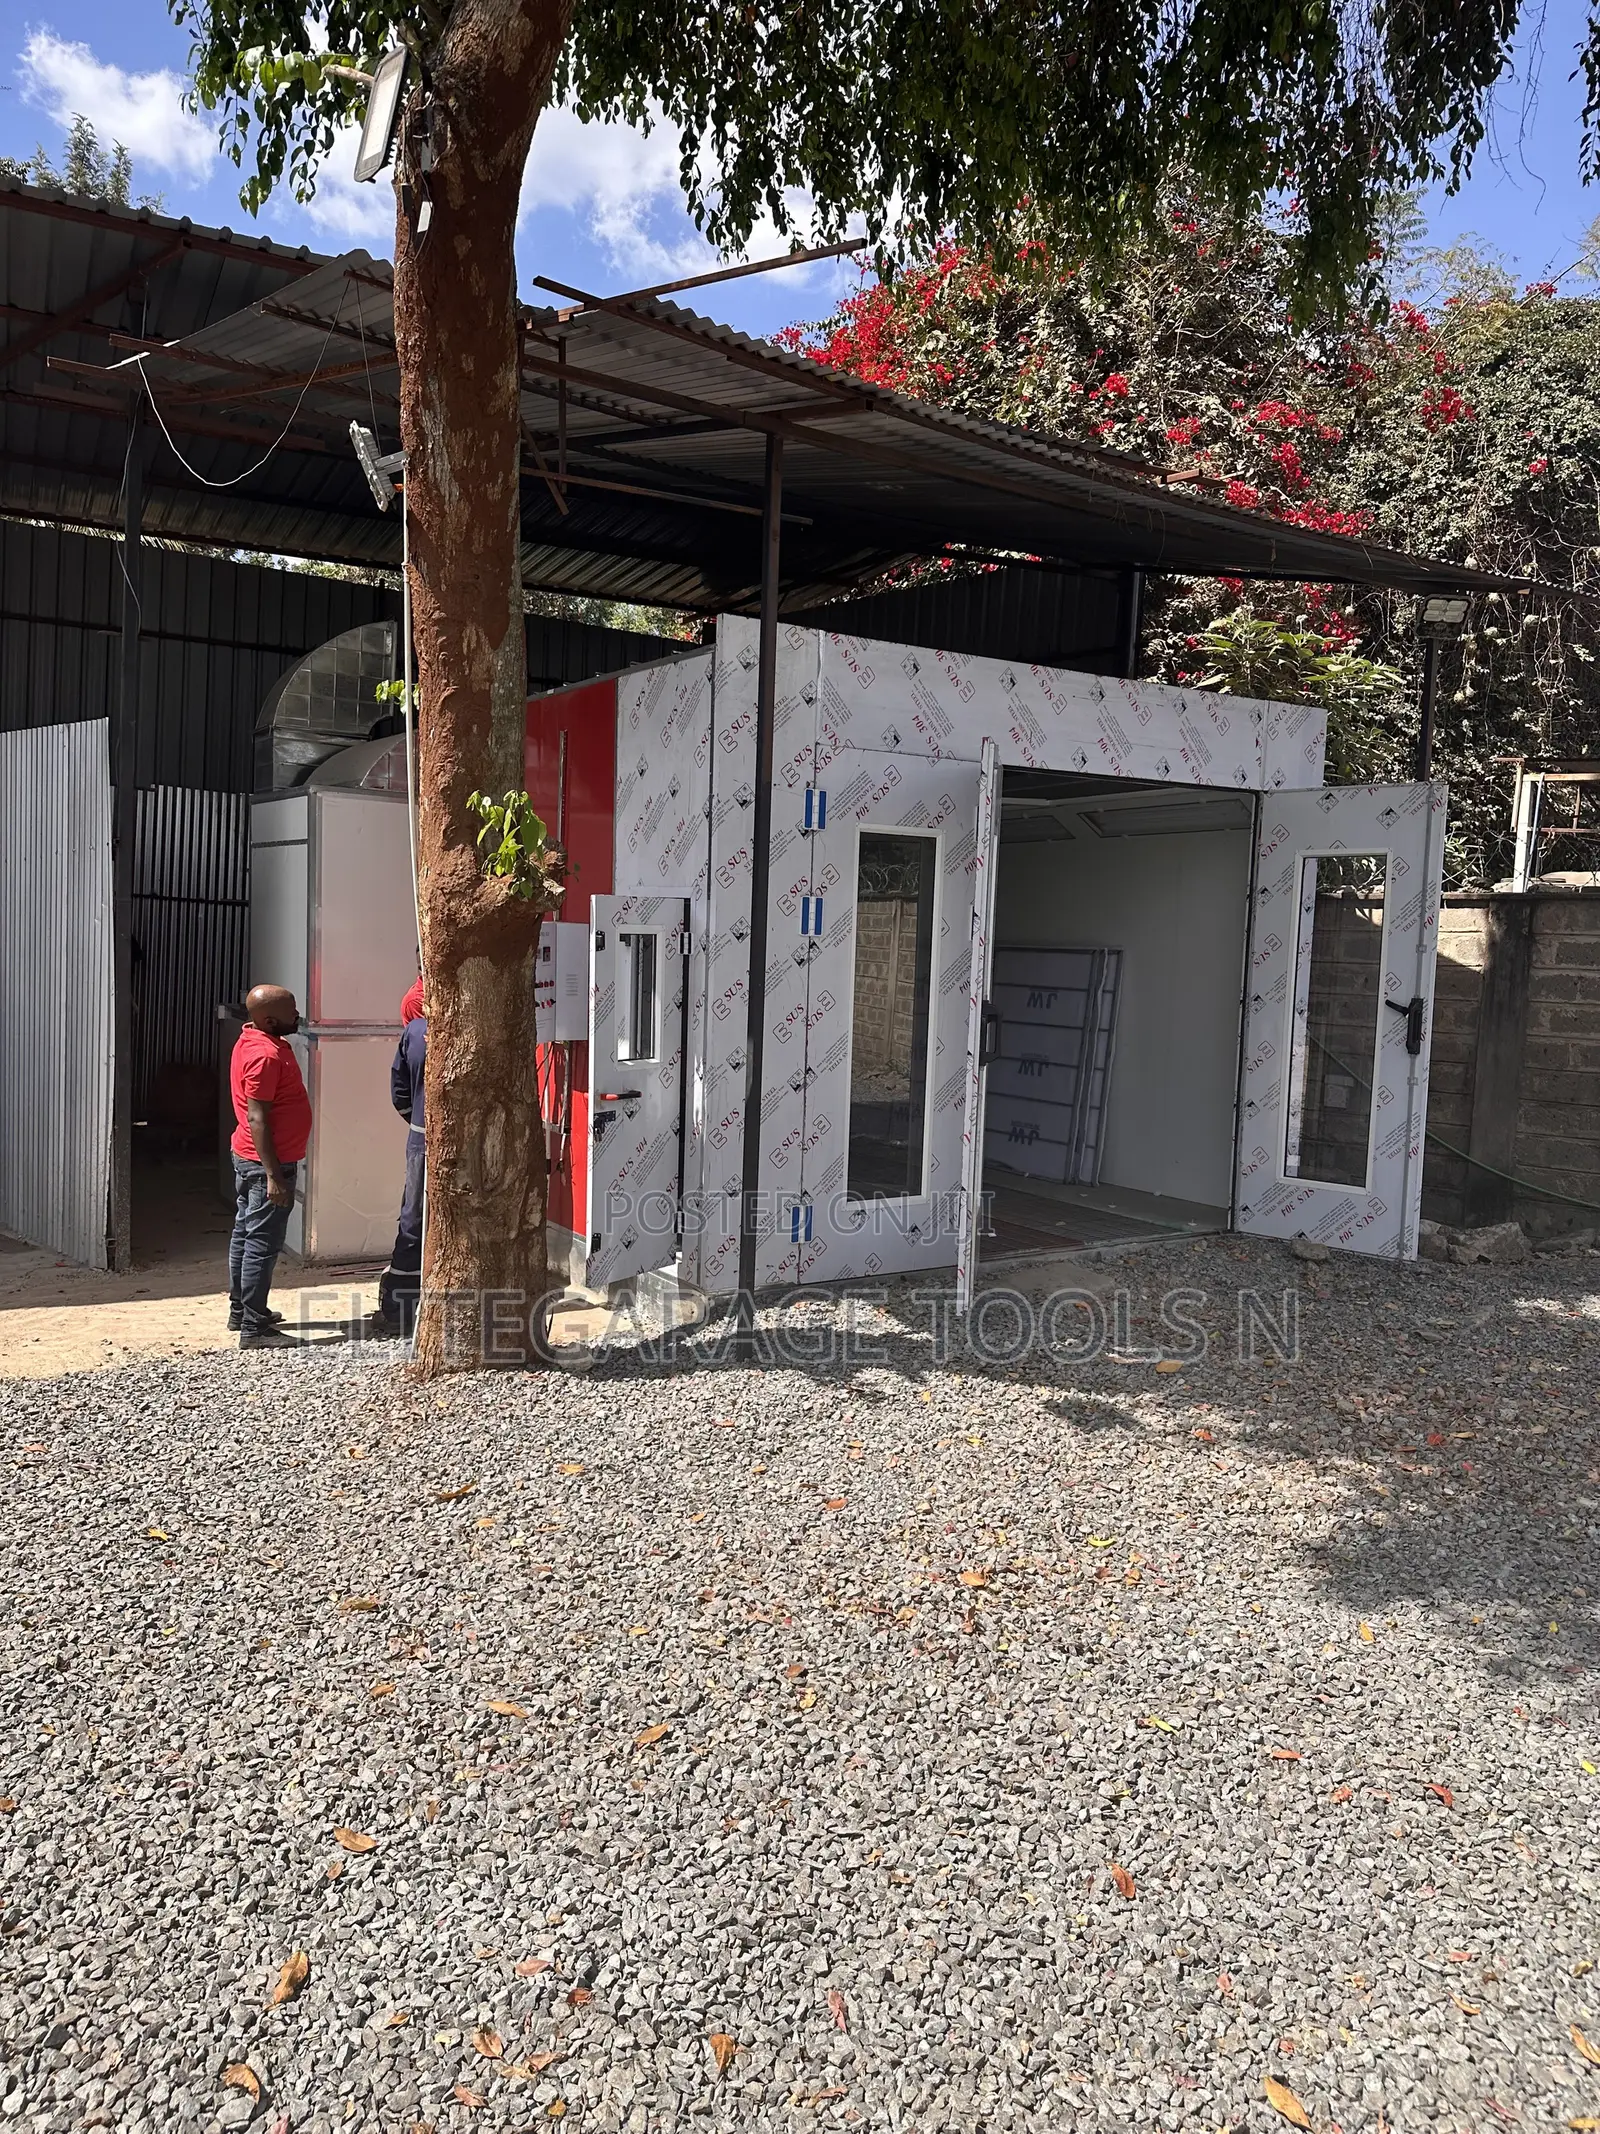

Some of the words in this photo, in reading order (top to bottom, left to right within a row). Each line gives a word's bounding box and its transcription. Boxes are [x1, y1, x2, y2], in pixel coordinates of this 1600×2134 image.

[830, 633, 844, 646] 30
[841, 649, 860, 673] SUS
[935, 650, 947, 662] 30
[944, 665, 962, 687] SUS
[1030, 664, 1041, 677] 30
[1039, 679, 1055, 700] SUS
[1126, 692, 1140, 712] SUS
[731, 711, 751, 734] SUS
[1206, 703, 1220, 723] SUS
[1274, 708, 1287, 725] SUS
[912, 715, 928, 733] 304
[822, 723, 840, 746] SUS
[1008, 727, 1023, 744] 304
[1312, 729, 1325, 748] SUS
[793, 744, 813, 768] SUS
[926, 736, 943, 760] SUS
[1097, 738, 1110, 754] 304
[1180, 747, 1192, 763] 304
[815, 754, 832, 774] SUS
[1020, 747, 1036, 767] SUS
[1108, 756, 1123, 776] SUS
[1190, 765, 1203, 785] SUS
[872, 781, 890, 804] SUS
[855, 802, 870, 820] 304
[728, 847, 748, 870] SUS
[1260, 841, 1278, 860] SUS
[789, 875, 809, 898] SUS
[621, 896, 638, 916] SUS
[671, 919, 685, 942] SUS
[1253, 949, 1271, 968] SUS
[724, 979, 744, 1001] SUS
[785, 1003, 805, 1026] SUS
[807, 1008, 824, 1030] SUS
[668, 1047, 682, 1070] SUS
[1247, 1055, 1264, 1074] SUS
[720, 1107, 740, 1130] SUS
[782, 1128, 800, 1150] SUS
[802, 1131, 820, 1155] SUS
[618, 1157, 634, 1181] SUS
[635, 1137, 649, 1157] 304
[1241, 1161, 1258, 1179] SUS
[665, 1173, 680, 1194] SUS
[1298, 1187, 1315, 1205] SUS
[1281, 1201, 1296, 1217] 304
[1356, 1212, 1375, 1231] SUS
[1339, 1226, 1355, 1244] 304
[717, 1234, 737, 1257] SUS
[778, 1251, 797, 1274] SUS
[797, 1253, 816, 1277] SUS
